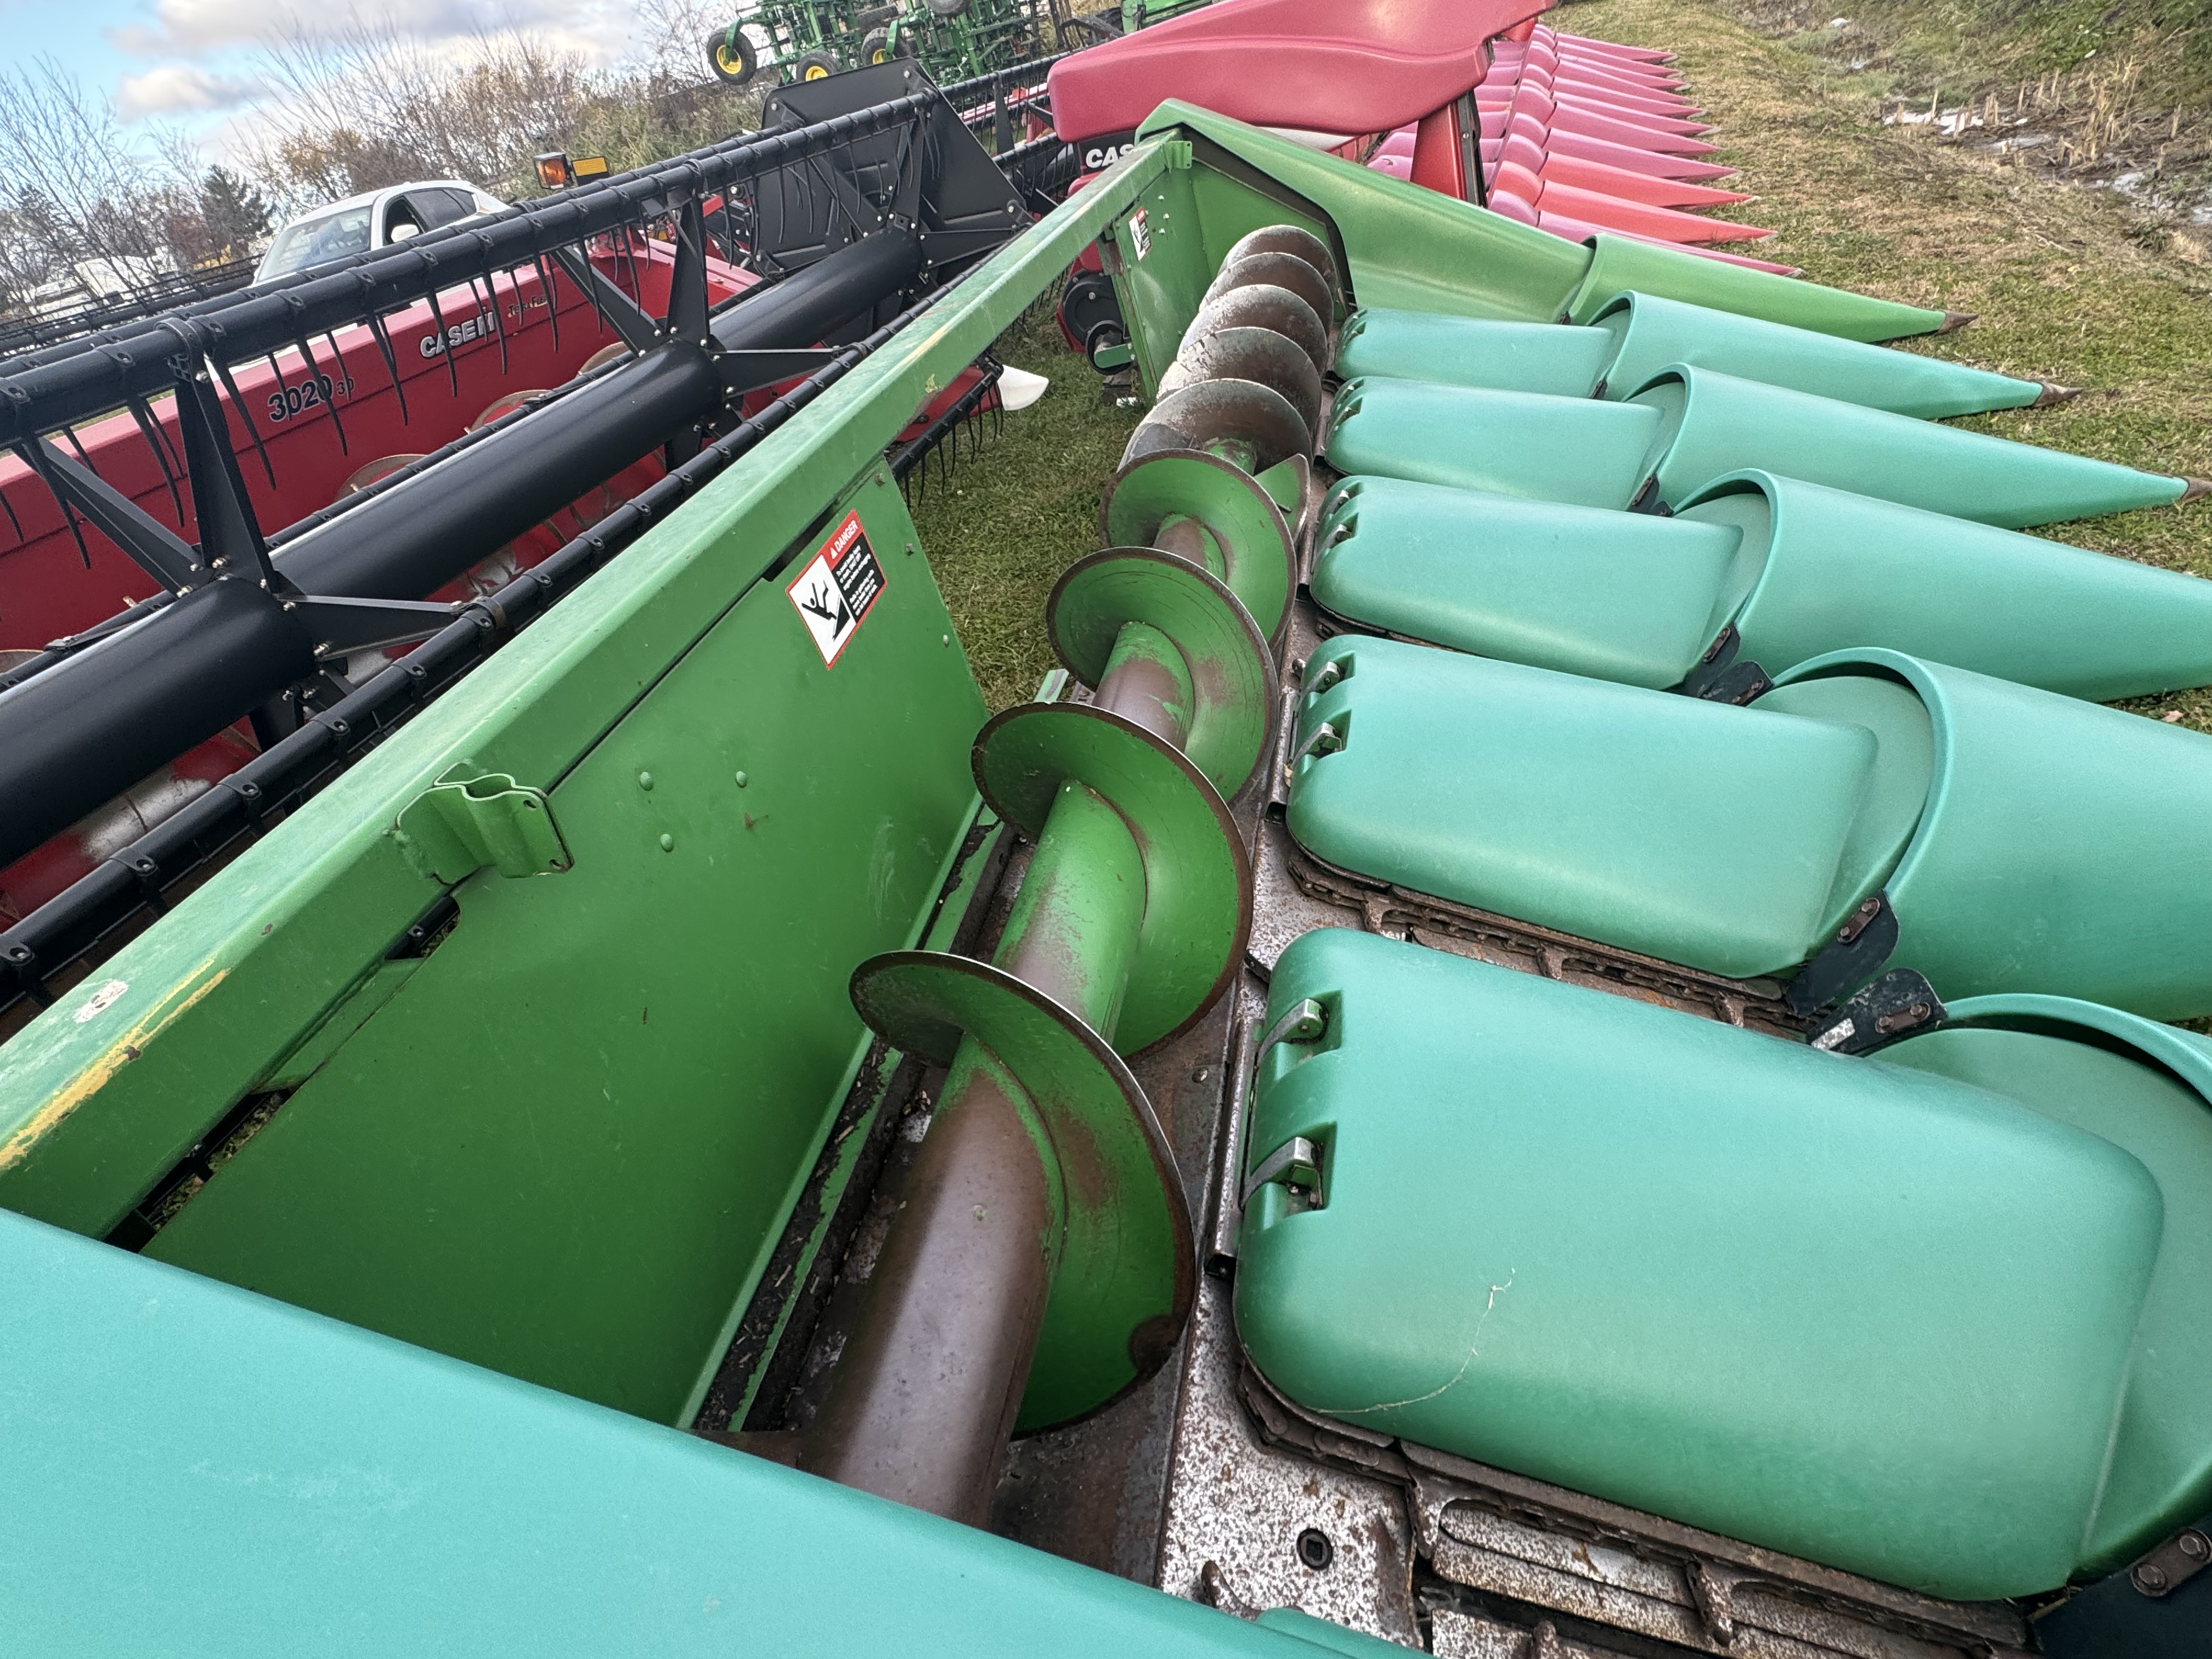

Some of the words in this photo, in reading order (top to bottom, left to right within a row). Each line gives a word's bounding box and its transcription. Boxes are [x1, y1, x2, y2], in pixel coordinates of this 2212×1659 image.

[1086, 144, 1134, 168] CAS
[268, 374, 334, 422] 3020
[834, 520, 857, 552] DANGER
